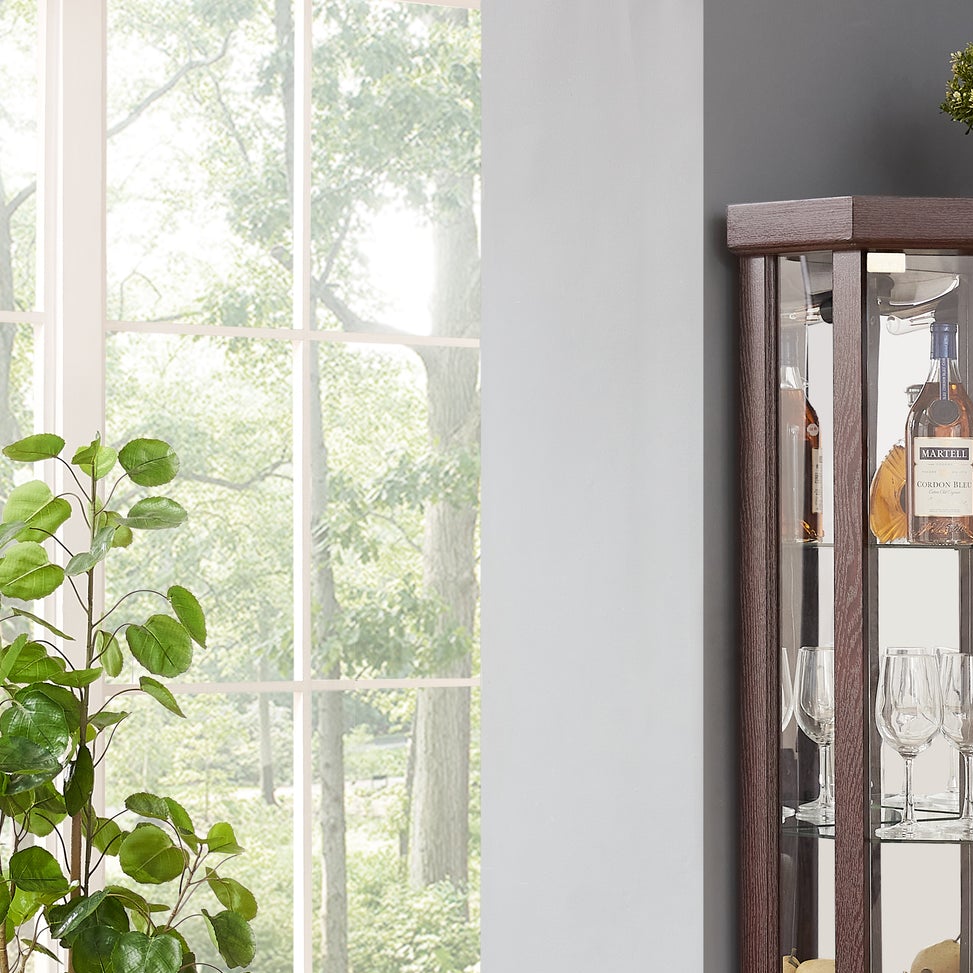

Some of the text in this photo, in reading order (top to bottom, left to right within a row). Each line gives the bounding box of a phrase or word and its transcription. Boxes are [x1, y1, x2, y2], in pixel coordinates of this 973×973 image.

[922, 449, 967, 458] MARTELL
[917, 480, 972, 489] CORDON BLEU
